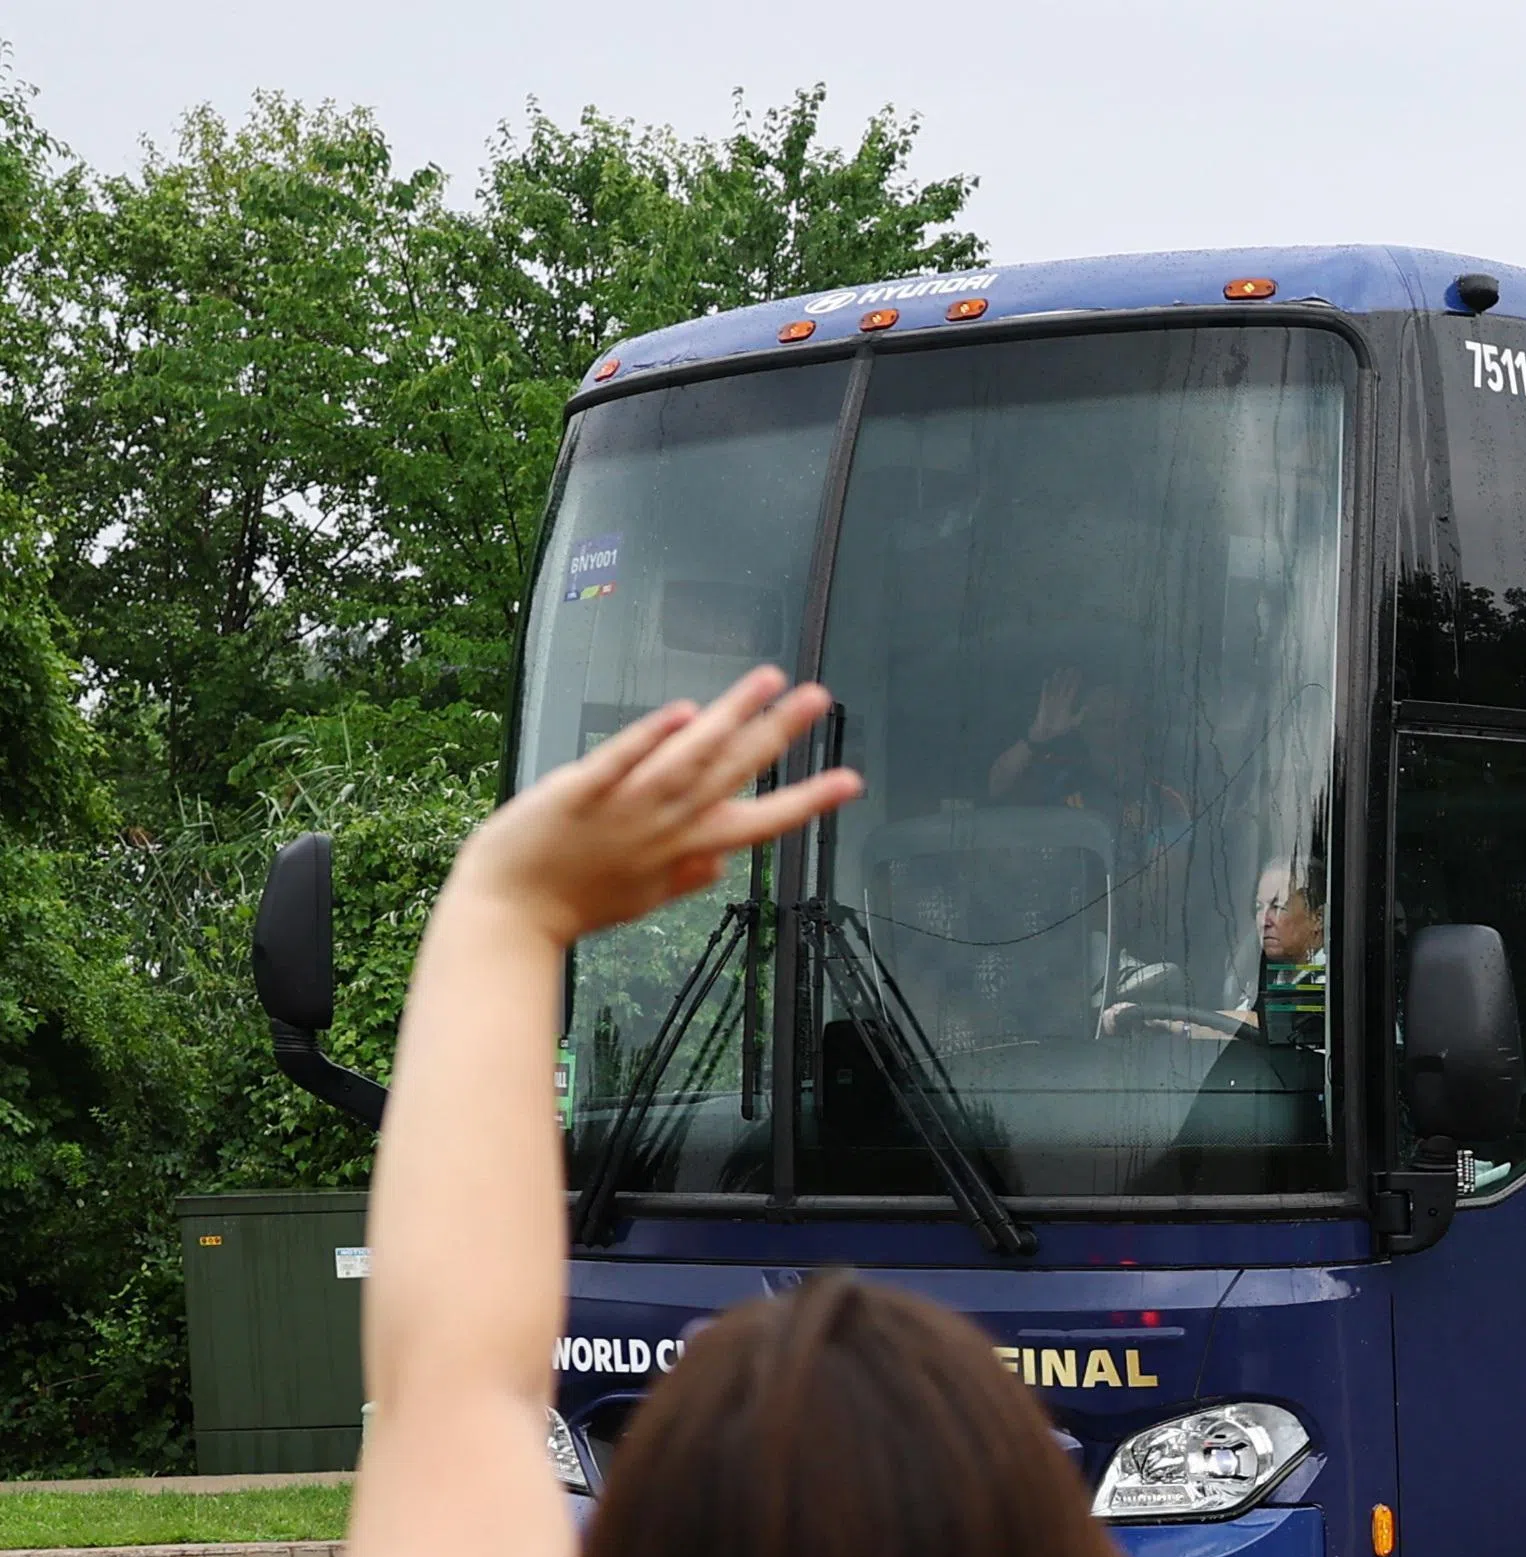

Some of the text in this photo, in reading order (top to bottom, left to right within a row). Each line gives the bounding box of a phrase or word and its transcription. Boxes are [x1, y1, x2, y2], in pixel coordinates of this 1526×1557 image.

[857, 274, 999, 304] HYUNDAI
[551, 1336, 651, 1373] WORLD
[992, 1346, 1159, 1388] FINAL
